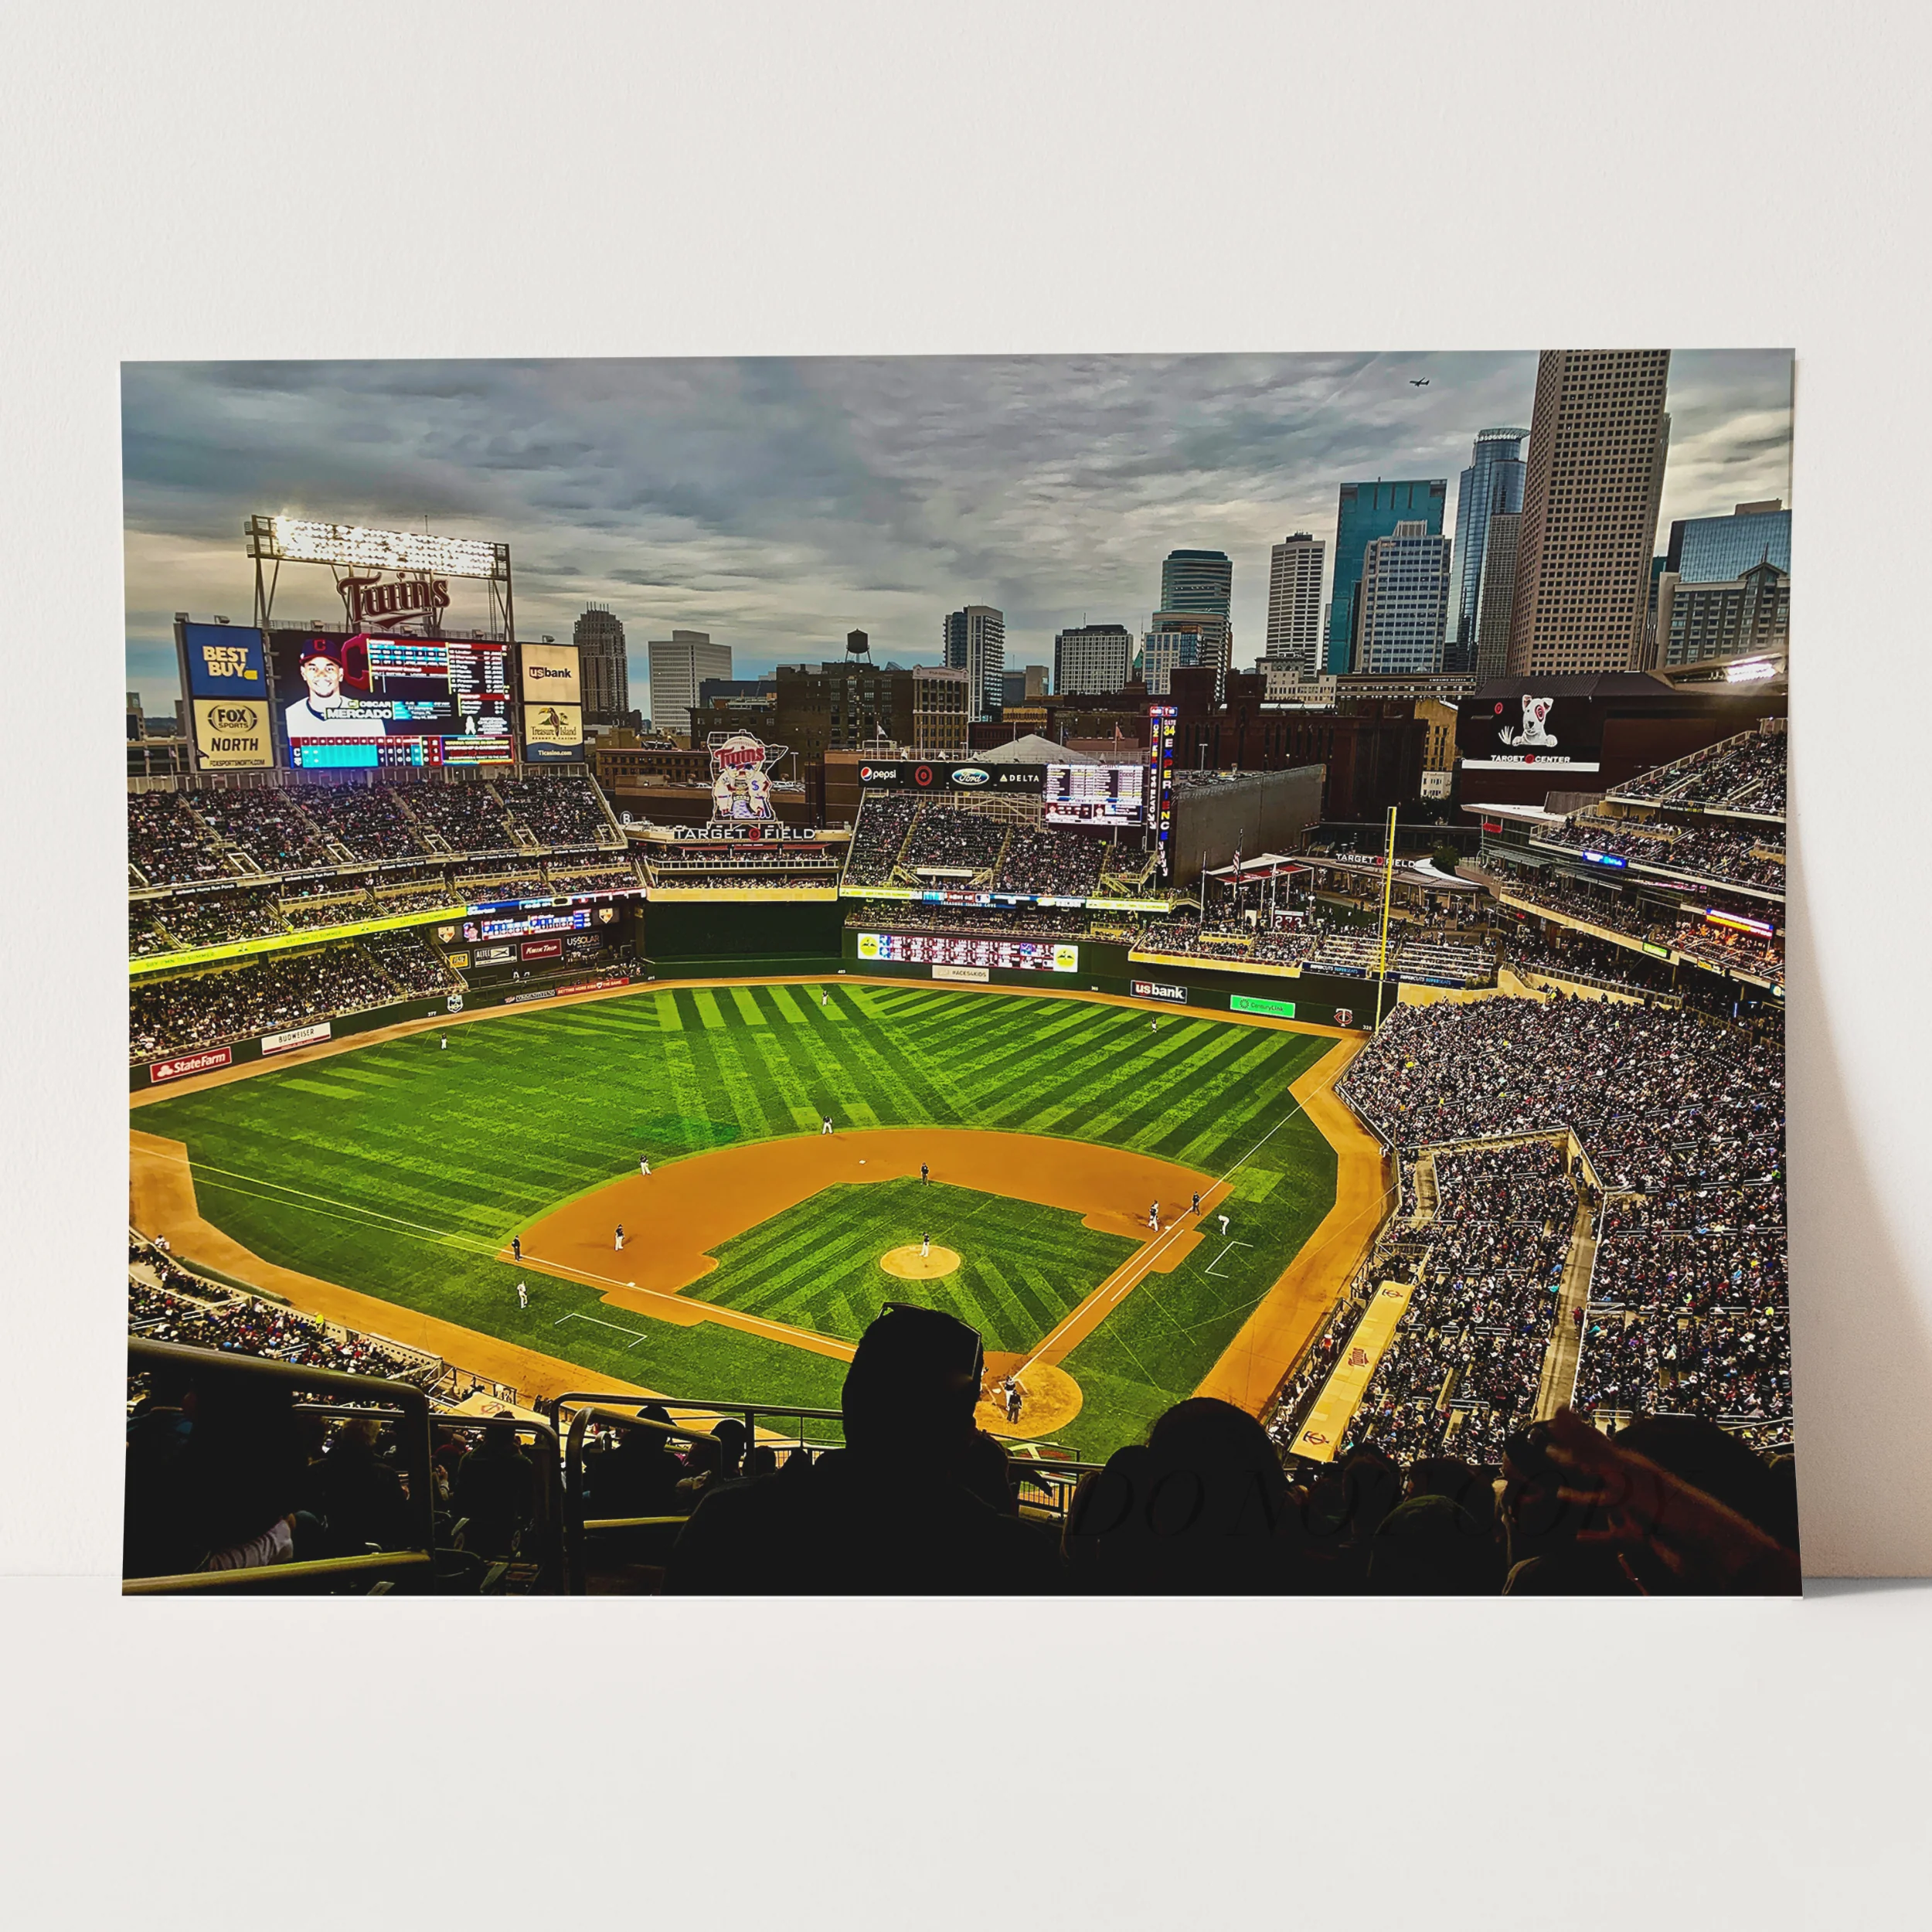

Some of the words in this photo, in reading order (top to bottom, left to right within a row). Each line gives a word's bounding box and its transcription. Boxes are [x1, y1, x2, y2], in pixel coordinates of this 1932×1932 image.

[337, 572, 451, 624] Twins
[202, 645, 248, 662] BEST
[208, 662, 246, 677] BUY
[530, 667, 571, 679] usbank
[218, 709, 247, 723] FOX
[327, 709, 392, 719] MERCADO
[531, 726, 554, 736] Treasure
[560, 726, 577, 736] Island
[1164, 726, 1175, 736] 34
[211, 737, 259, 752] NORTH
[714, 746, 765, 769] Twins
[873, 770, 896, 780] pepsi
[959, 771, 981, 783] Ford
[1161, 739, 1173, 840] EXPERIENCE
[623, 813, 631, 824] B
[675, 828, 747, 839] TARGET
[764, 829, 815, 840] FIELD
[1336, 853, 1375, 864] TARGET
[1135, 983, 1185, 999] usbank
[278, 1029, 315, 1043] BUDWEISER
